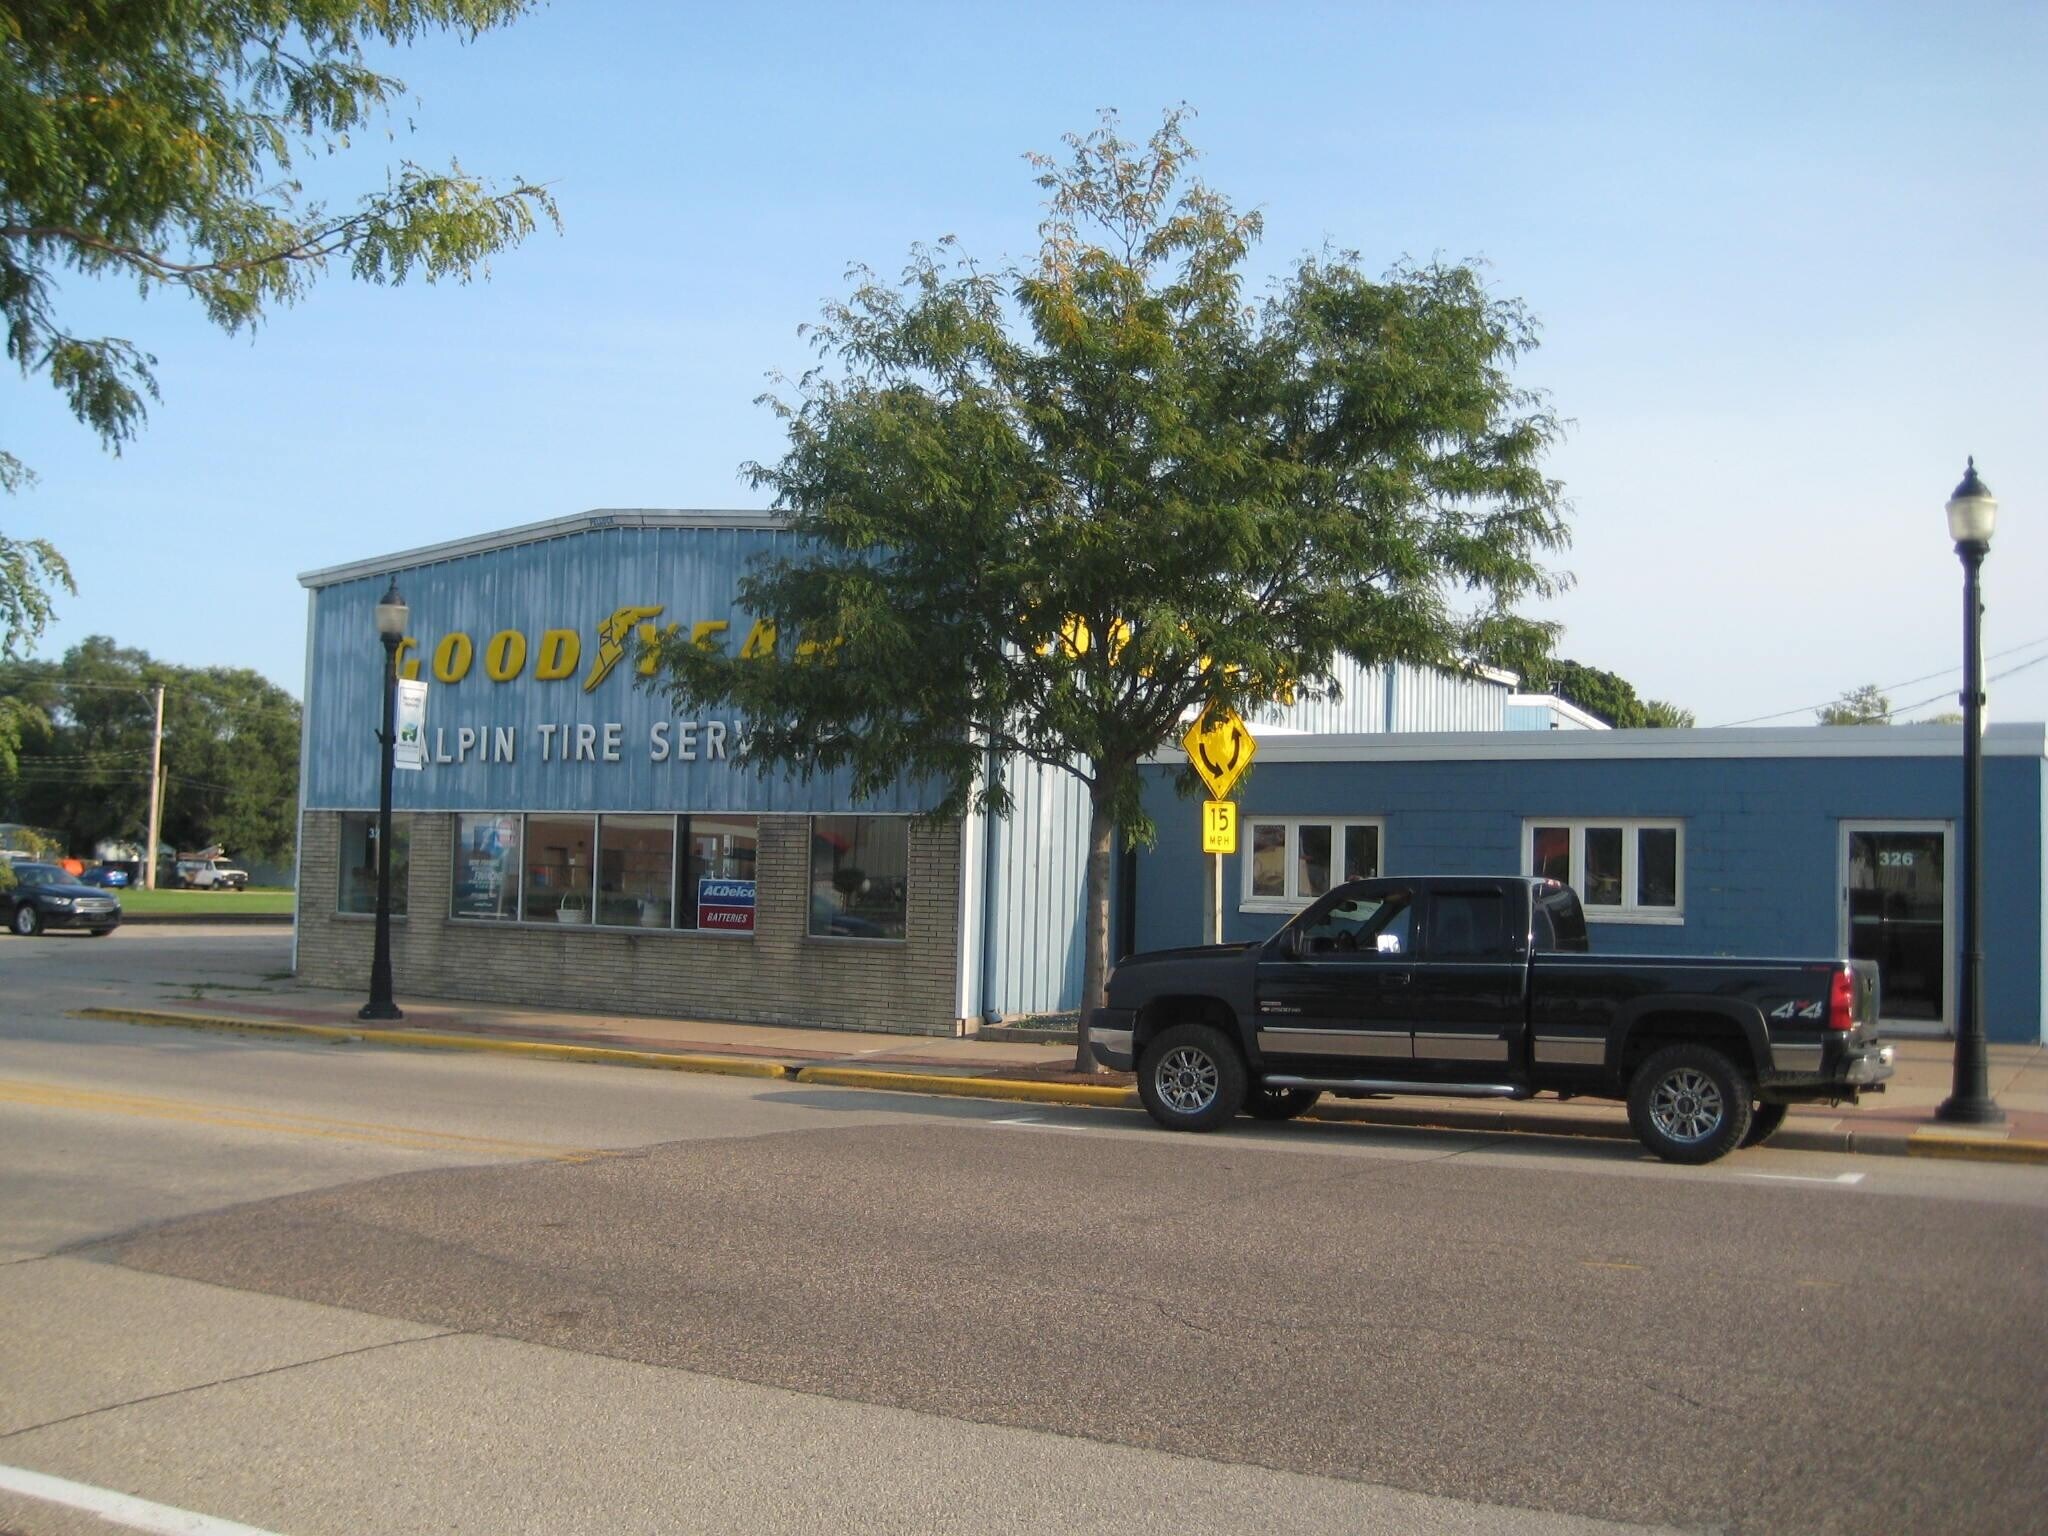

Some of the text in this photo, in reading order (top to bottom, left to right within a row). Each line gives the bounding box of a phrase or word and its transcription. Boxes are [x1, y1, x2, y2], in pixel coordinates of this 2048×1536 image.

[395, 615, 845, 684] GOODYEA
[537, 723, 622, 761] TIRE
[1211, 808, 1229, 831] 15
[1210, 836, 1230, 845] MPH
[1880, 852, 1913, 866] 326
[704, 885, 755, 898] ACDelco
[707, 912, 748, 923] BATTERIES
